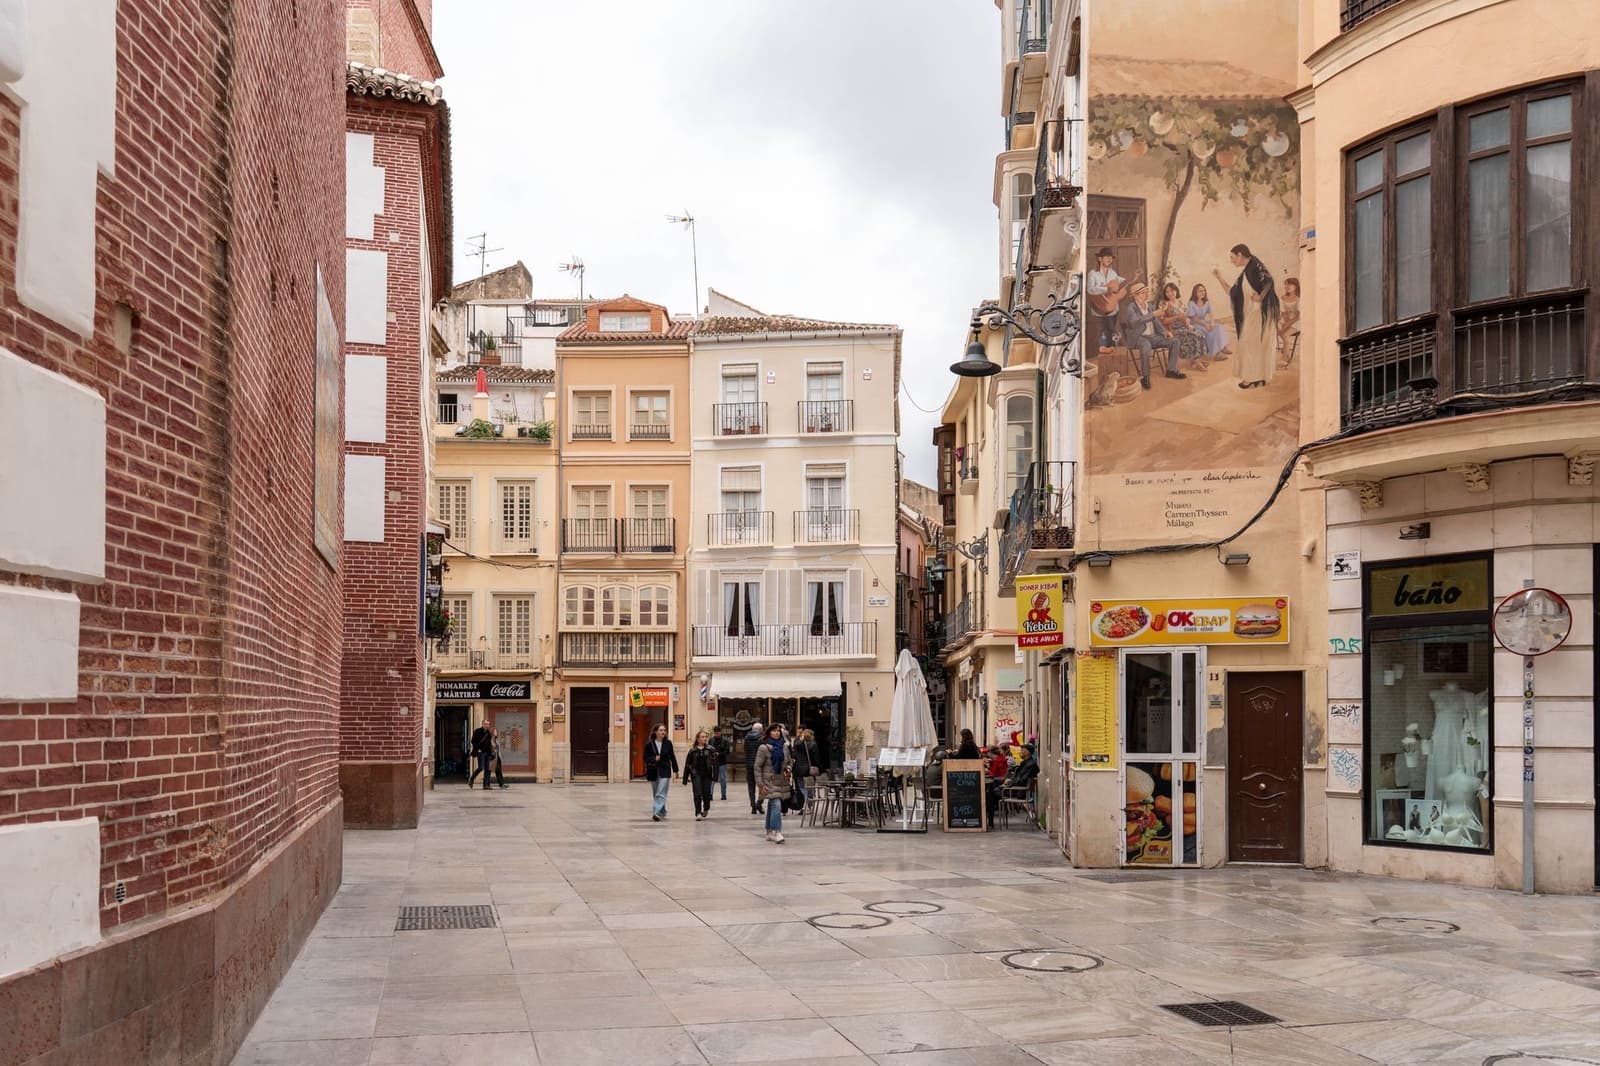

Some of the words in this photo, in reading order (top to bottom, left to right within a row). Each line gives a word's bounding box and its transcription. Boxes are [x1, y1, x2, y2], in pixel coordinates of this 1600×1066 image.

[1165, 501, 1192, 510] Museo
[1166, 518, 1194, 528] Málaga
[1394, 574, 1463, 607] baño
[1028, 608, 1052, 622] OK
[1023, 620, 1058, 633] Kebab
[1022, 636, 1039, 644] TAKE
[1040, 634, 1060, 642] AWAY
[436, 682, 478, 690] INIMARKET
